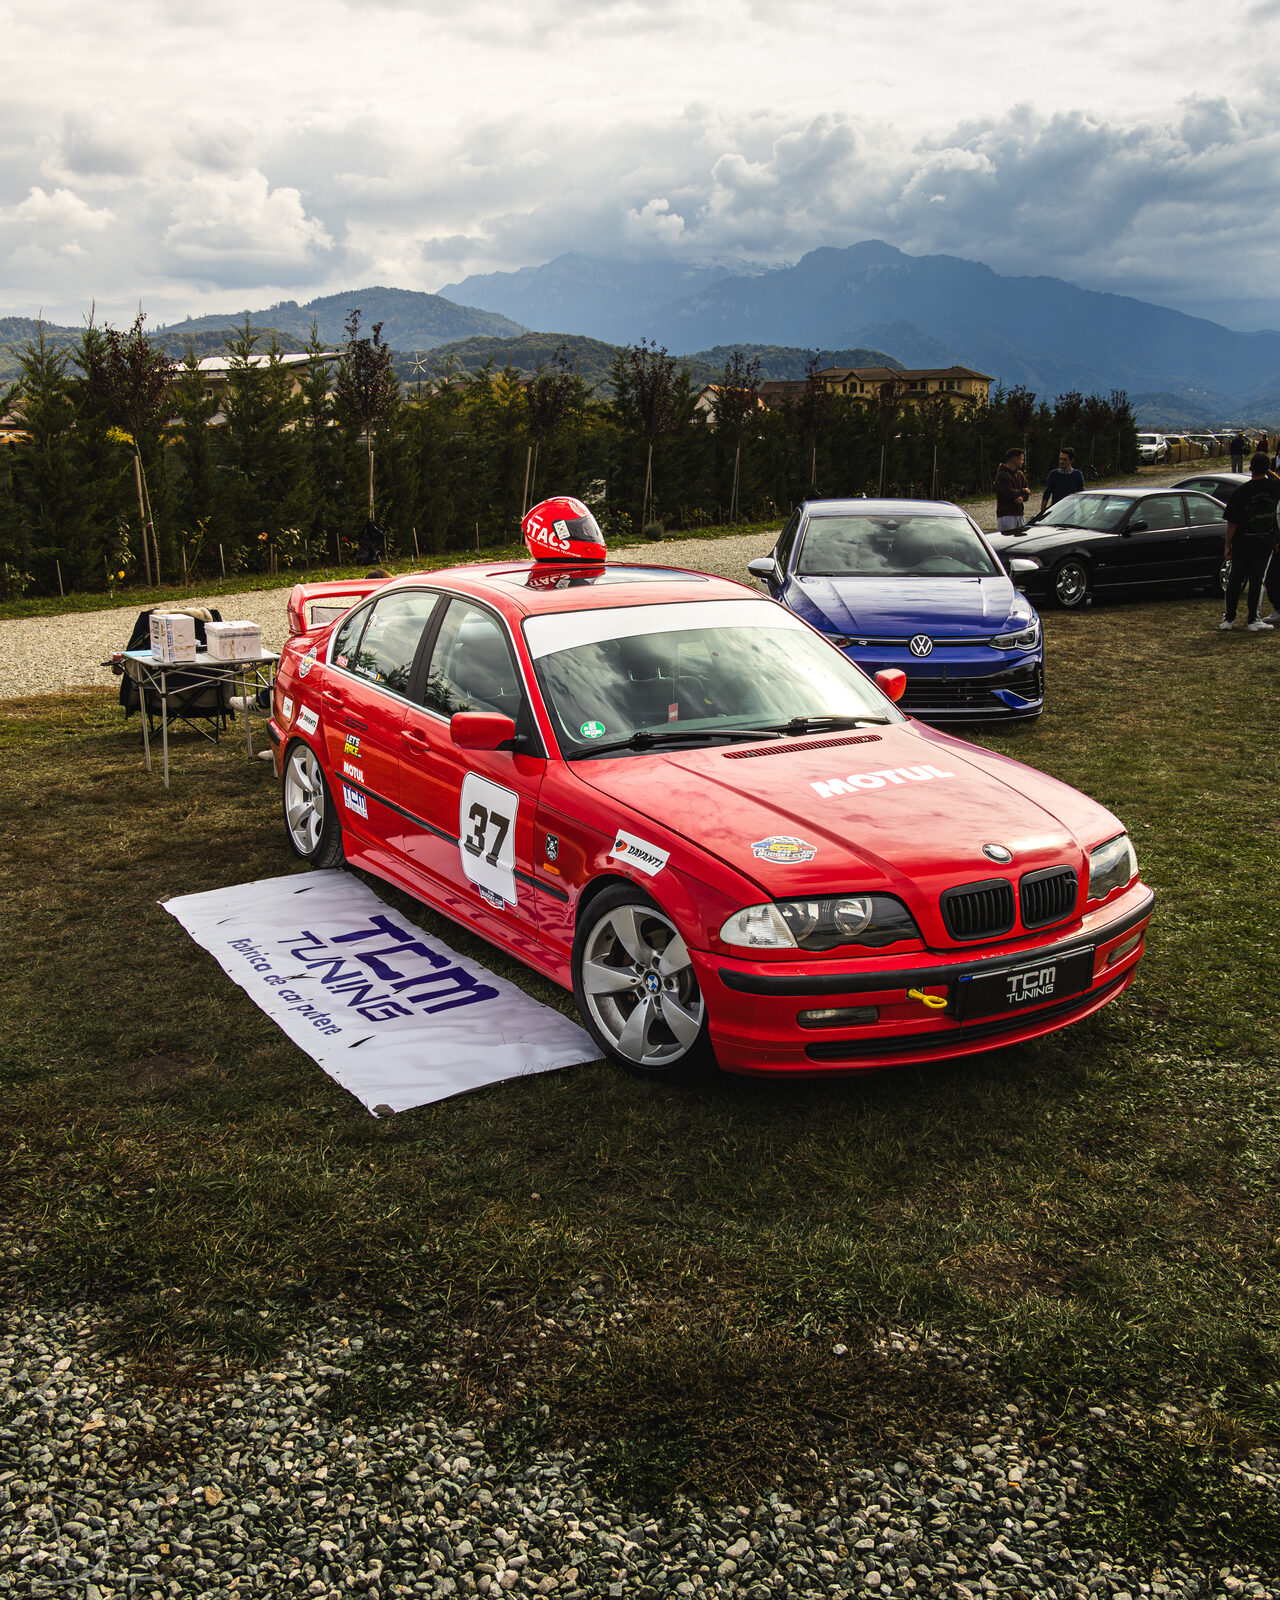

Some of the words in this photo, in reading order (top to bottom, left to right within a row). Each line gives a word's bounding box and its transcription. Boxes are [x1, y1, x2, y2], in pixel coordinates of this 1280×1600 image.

[343, 761, 364, 783] MOTUL
[809, 765, 956, 798] MOTUL
[342, 783, 366, 810] TCM
[464, 802, 510, 868] 37
[627, 845, 664, 868] DAVANTI
[757, 850, 791, 858] BUDGET
[226, 938, 273, 972] Fabrica
[330, 914, 500, 1014] TCM
[263, 974, 287, 986] de
[1007, 966, 1056, 992] TCM
[278, 988, 314, 1004] cai
[1006, 983, 1054, 1003] TUNING
[287, 1004, 343, 1036] putere
